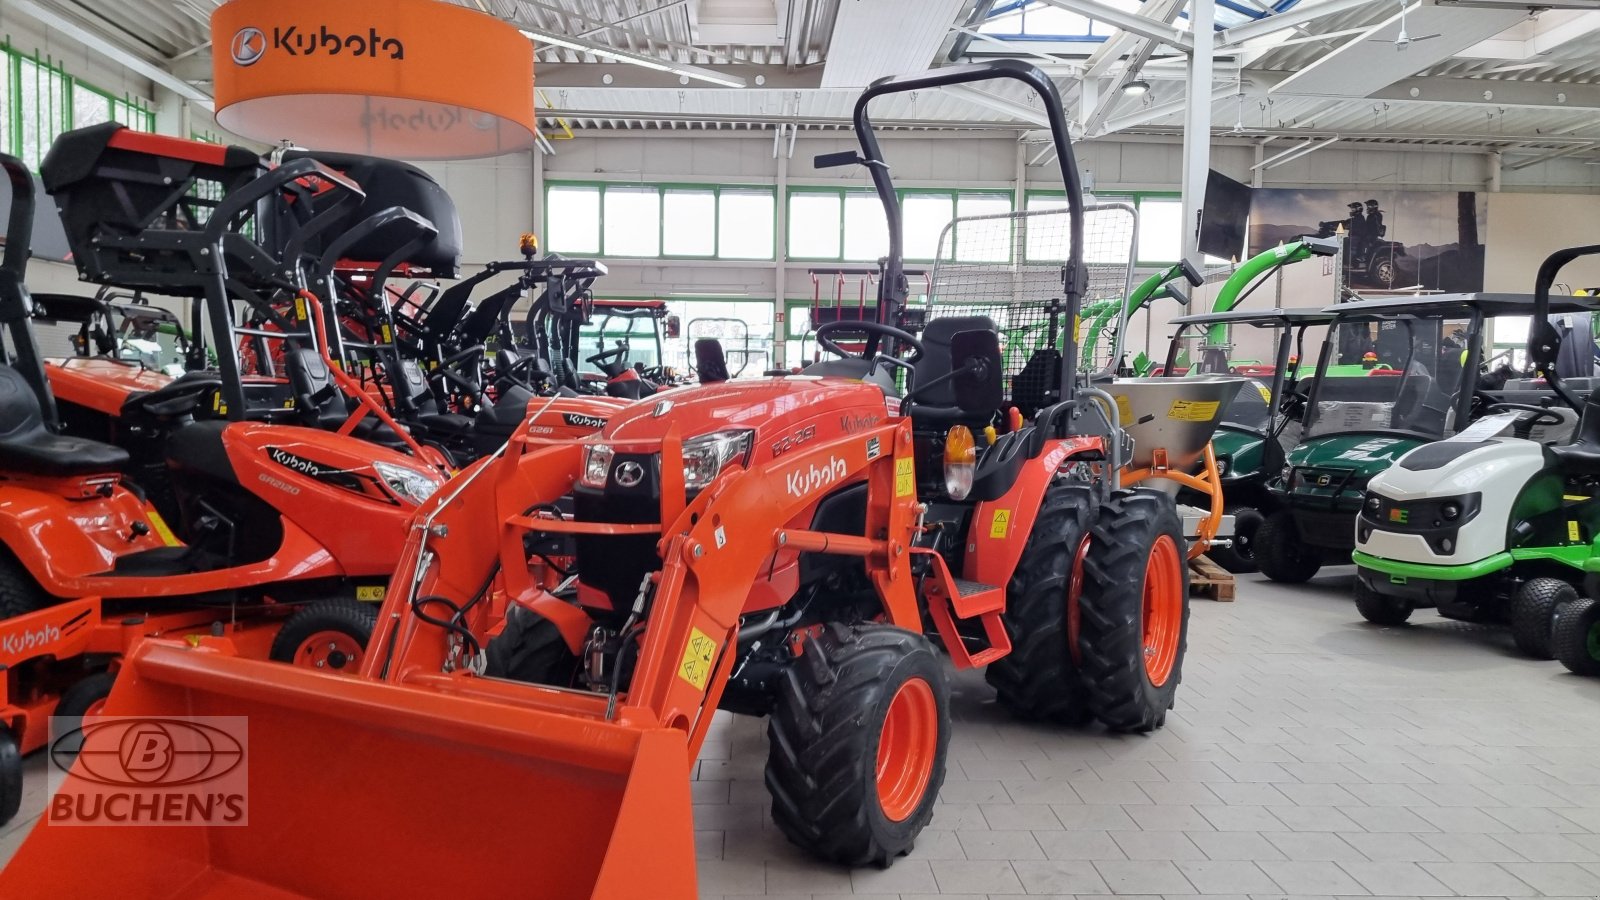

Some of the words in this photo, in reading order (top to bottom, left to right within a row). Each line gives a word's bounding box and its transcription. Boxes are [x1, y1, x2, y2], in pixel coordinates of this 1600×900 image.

[273, 25, 404, 60] Kubota
[273, 449, 319, 476] Kubota
[786, 455, 847, 497] Kubota
[2, 624, 60, 655] Kubota
